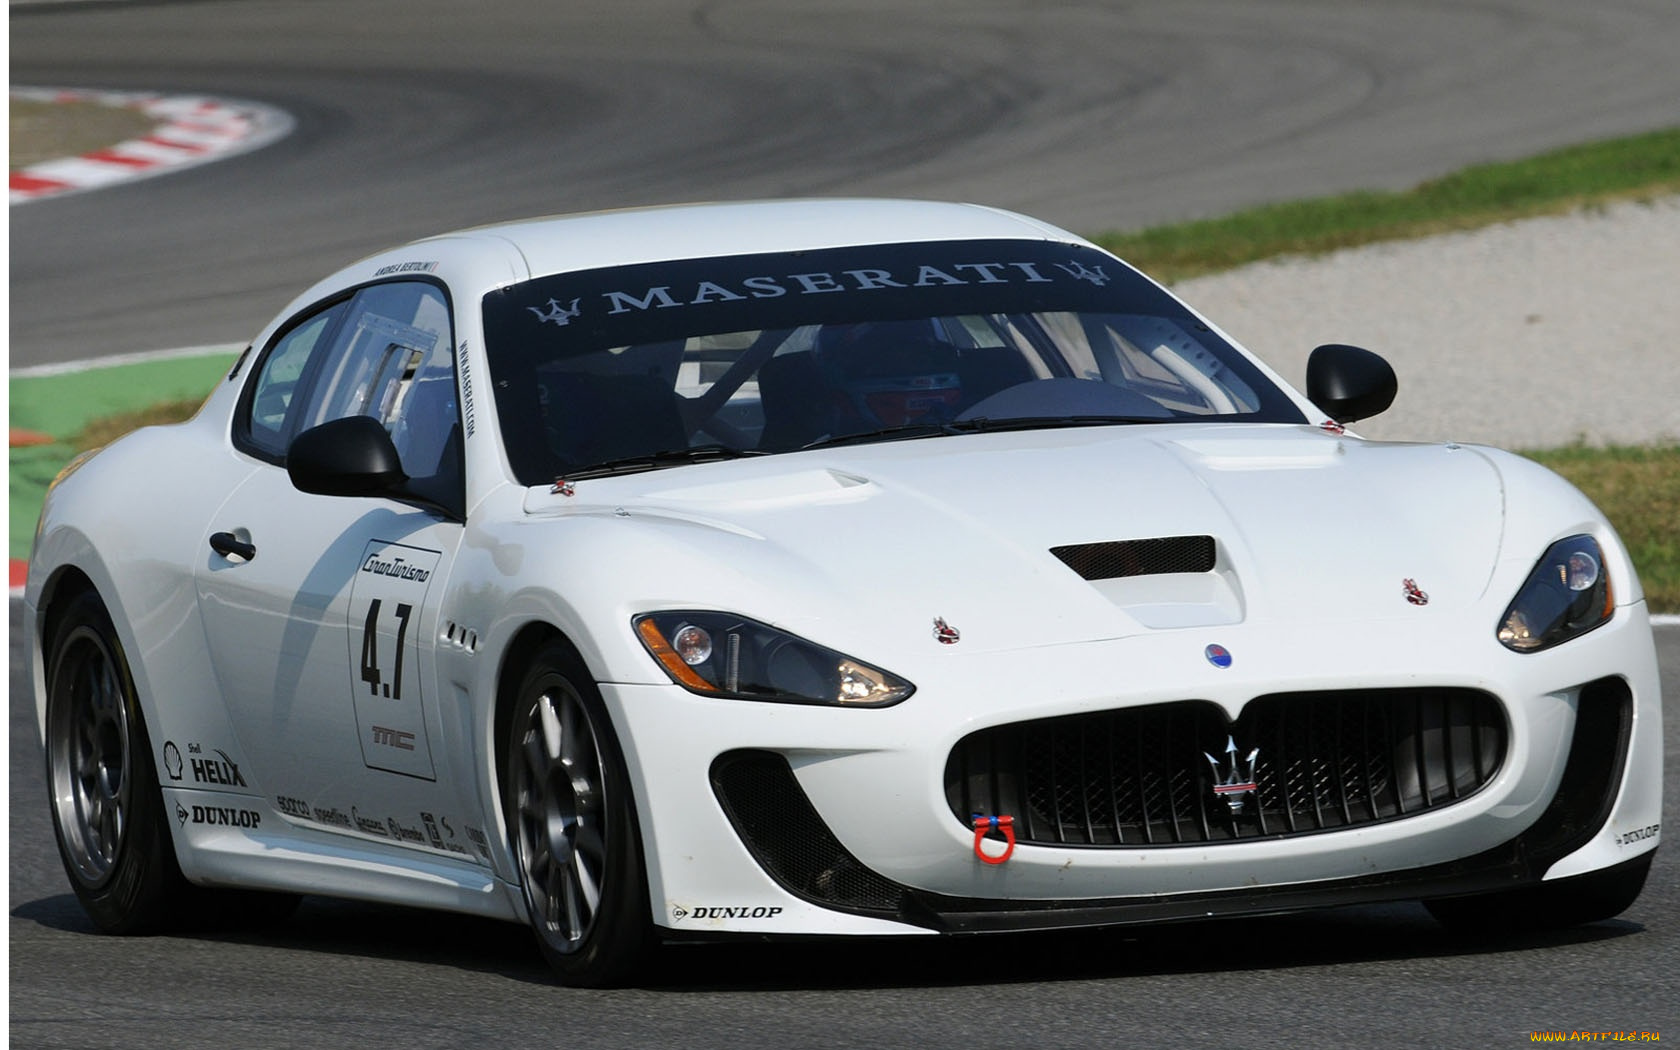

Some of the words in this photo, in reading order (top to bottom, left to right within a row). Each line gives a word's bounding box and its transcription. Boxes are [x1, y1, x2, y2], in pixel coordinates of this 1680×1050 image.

[602, 262, 1053, 315] MASERATI
[361, 598, 412, 700] 4.7
[188, 743, 202, 753] Shell
[190, 756, 248, 788] HELIX
[191, 805, 261, 829] DUNLOP
[1622, 823, 1660, 845] DUNLOP
[691, 906, 783, 919] DUNLOP
